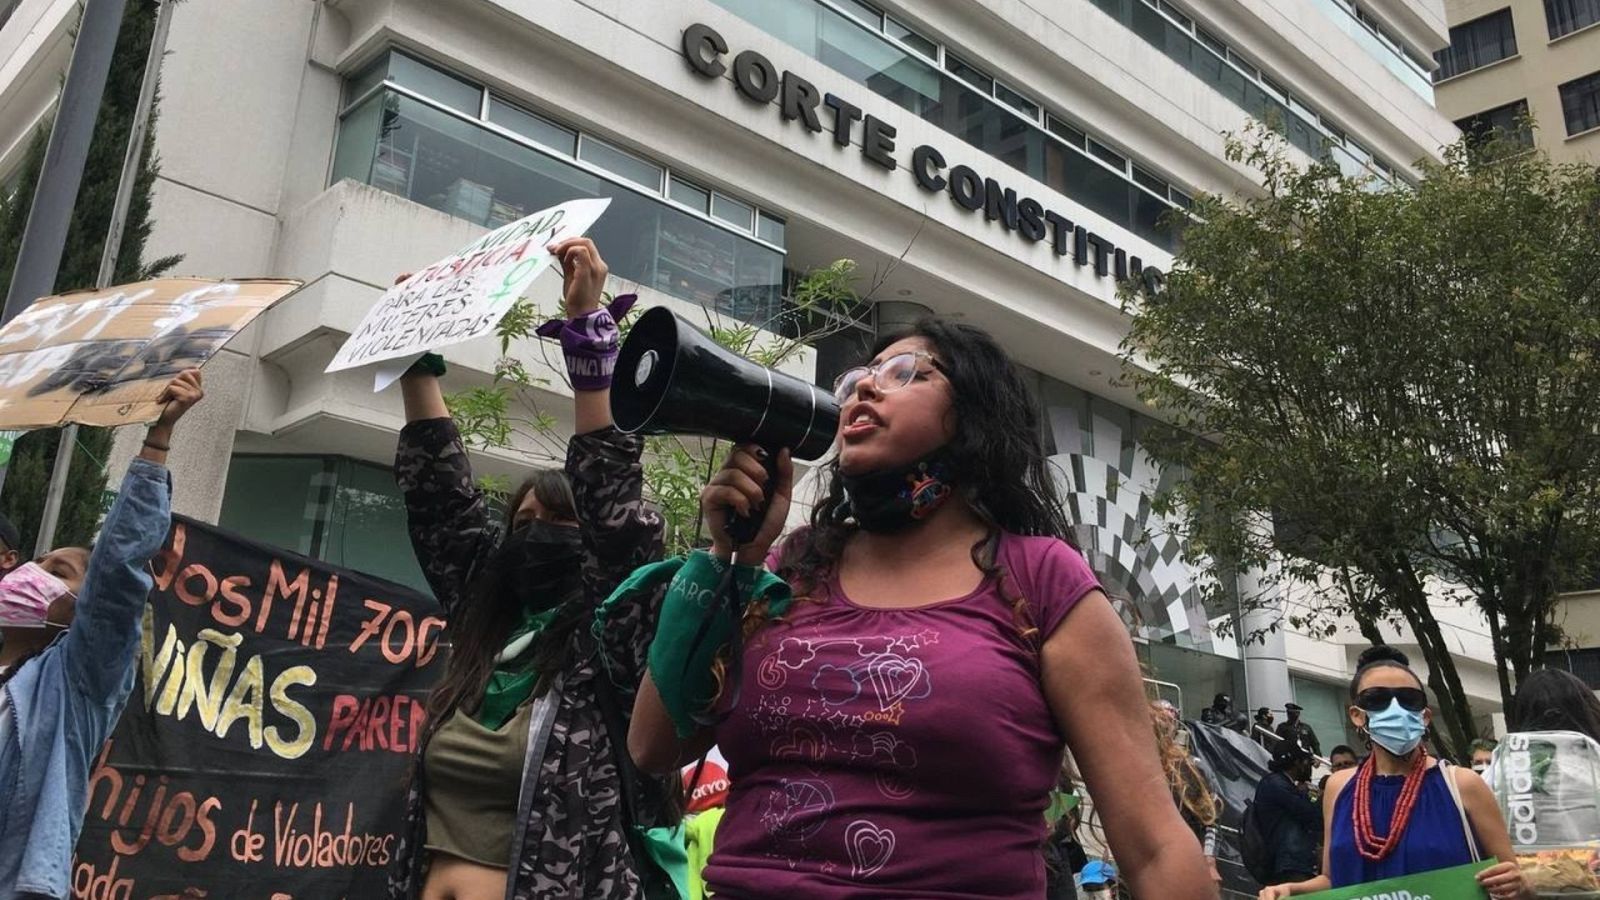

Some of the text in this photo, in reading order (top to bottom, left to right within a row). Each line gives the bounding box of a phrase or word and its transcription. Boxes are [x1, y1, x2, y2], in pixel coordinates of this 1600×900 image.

[682, 23, 896, 170] CORTE
[376, 276, 474, 317] PARA LAS
[255, 559, 339, 650] Mil
[87, 738, 394, 867] hijos de Violadores
[71, 852, 136, 900] ada
